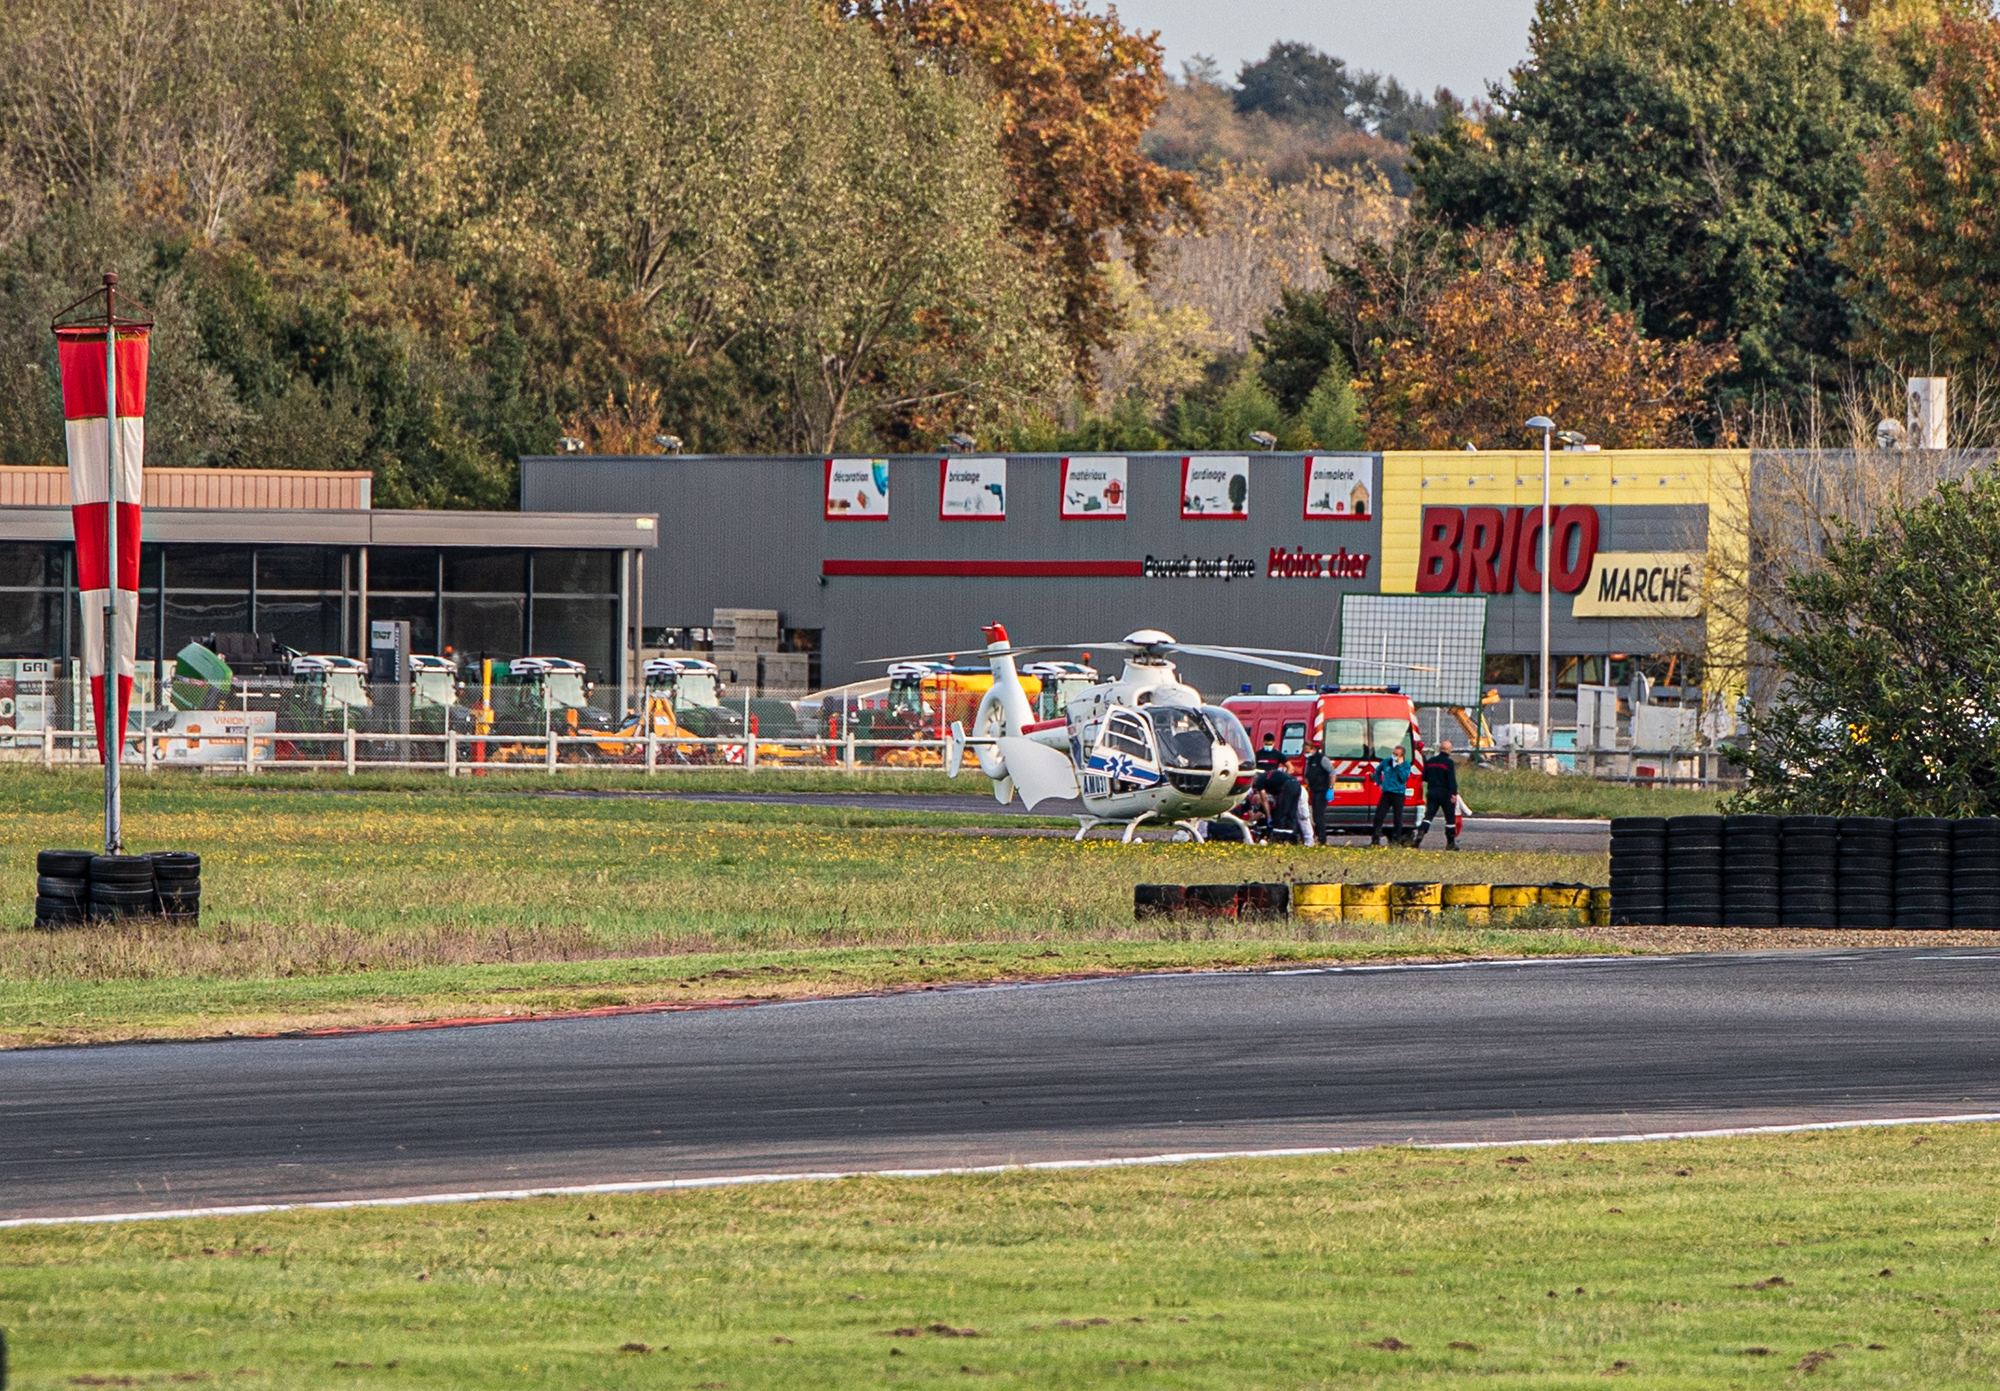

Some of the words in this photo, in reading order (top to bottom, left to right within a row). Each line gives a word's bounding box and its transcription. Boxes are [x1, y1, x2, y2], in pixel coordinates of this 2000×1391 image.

[949, 470, 981, 484] bricolage
[1069, 469, 1107, 480] matériaux
[1190, 469, 1227, 482] jardinage
[1313, 469, 1354, 480] animalerie
[1415, 505, 1599, 593] BRICO
[1267, 546, 1322, 579] Moins
[1328, 546, 1371, 579] cher
[1599, 565, 1692, 603] MARCHÉ
